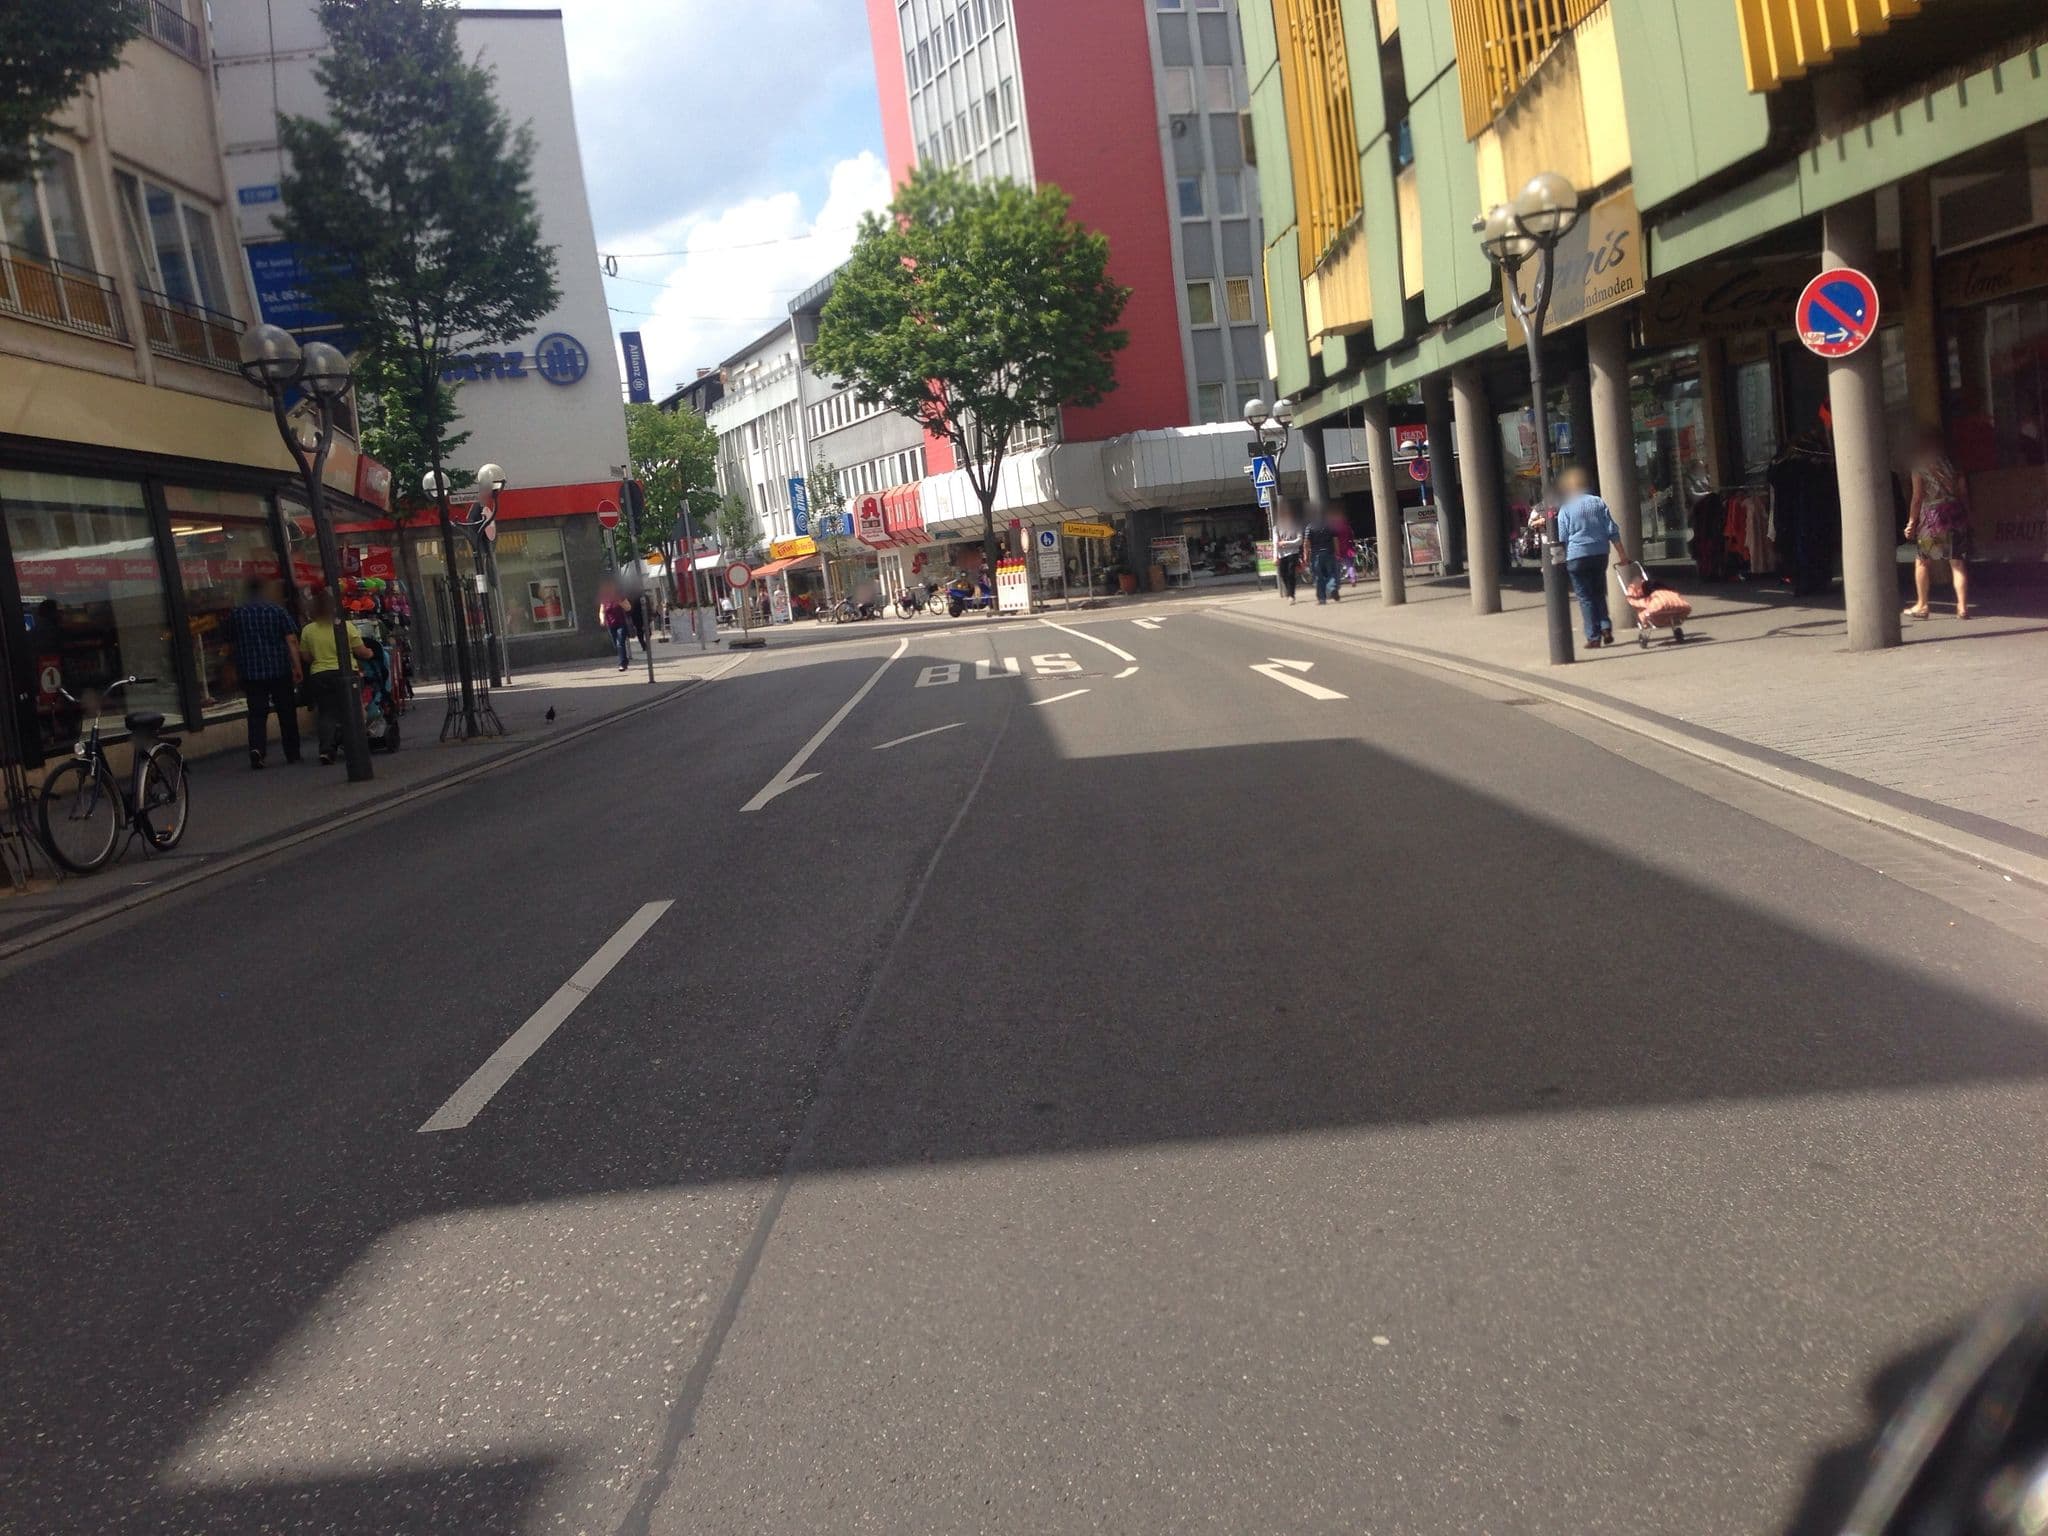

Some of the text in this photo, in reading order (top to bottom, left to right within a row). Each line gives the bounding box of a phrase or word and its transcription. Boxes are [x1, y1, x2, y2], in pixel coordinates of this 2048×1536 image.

[628, 344, 641, 382] Allianz
[1067, 525, 1105, 537] Umleitung
[914, 652, 1083, 688] BUS
